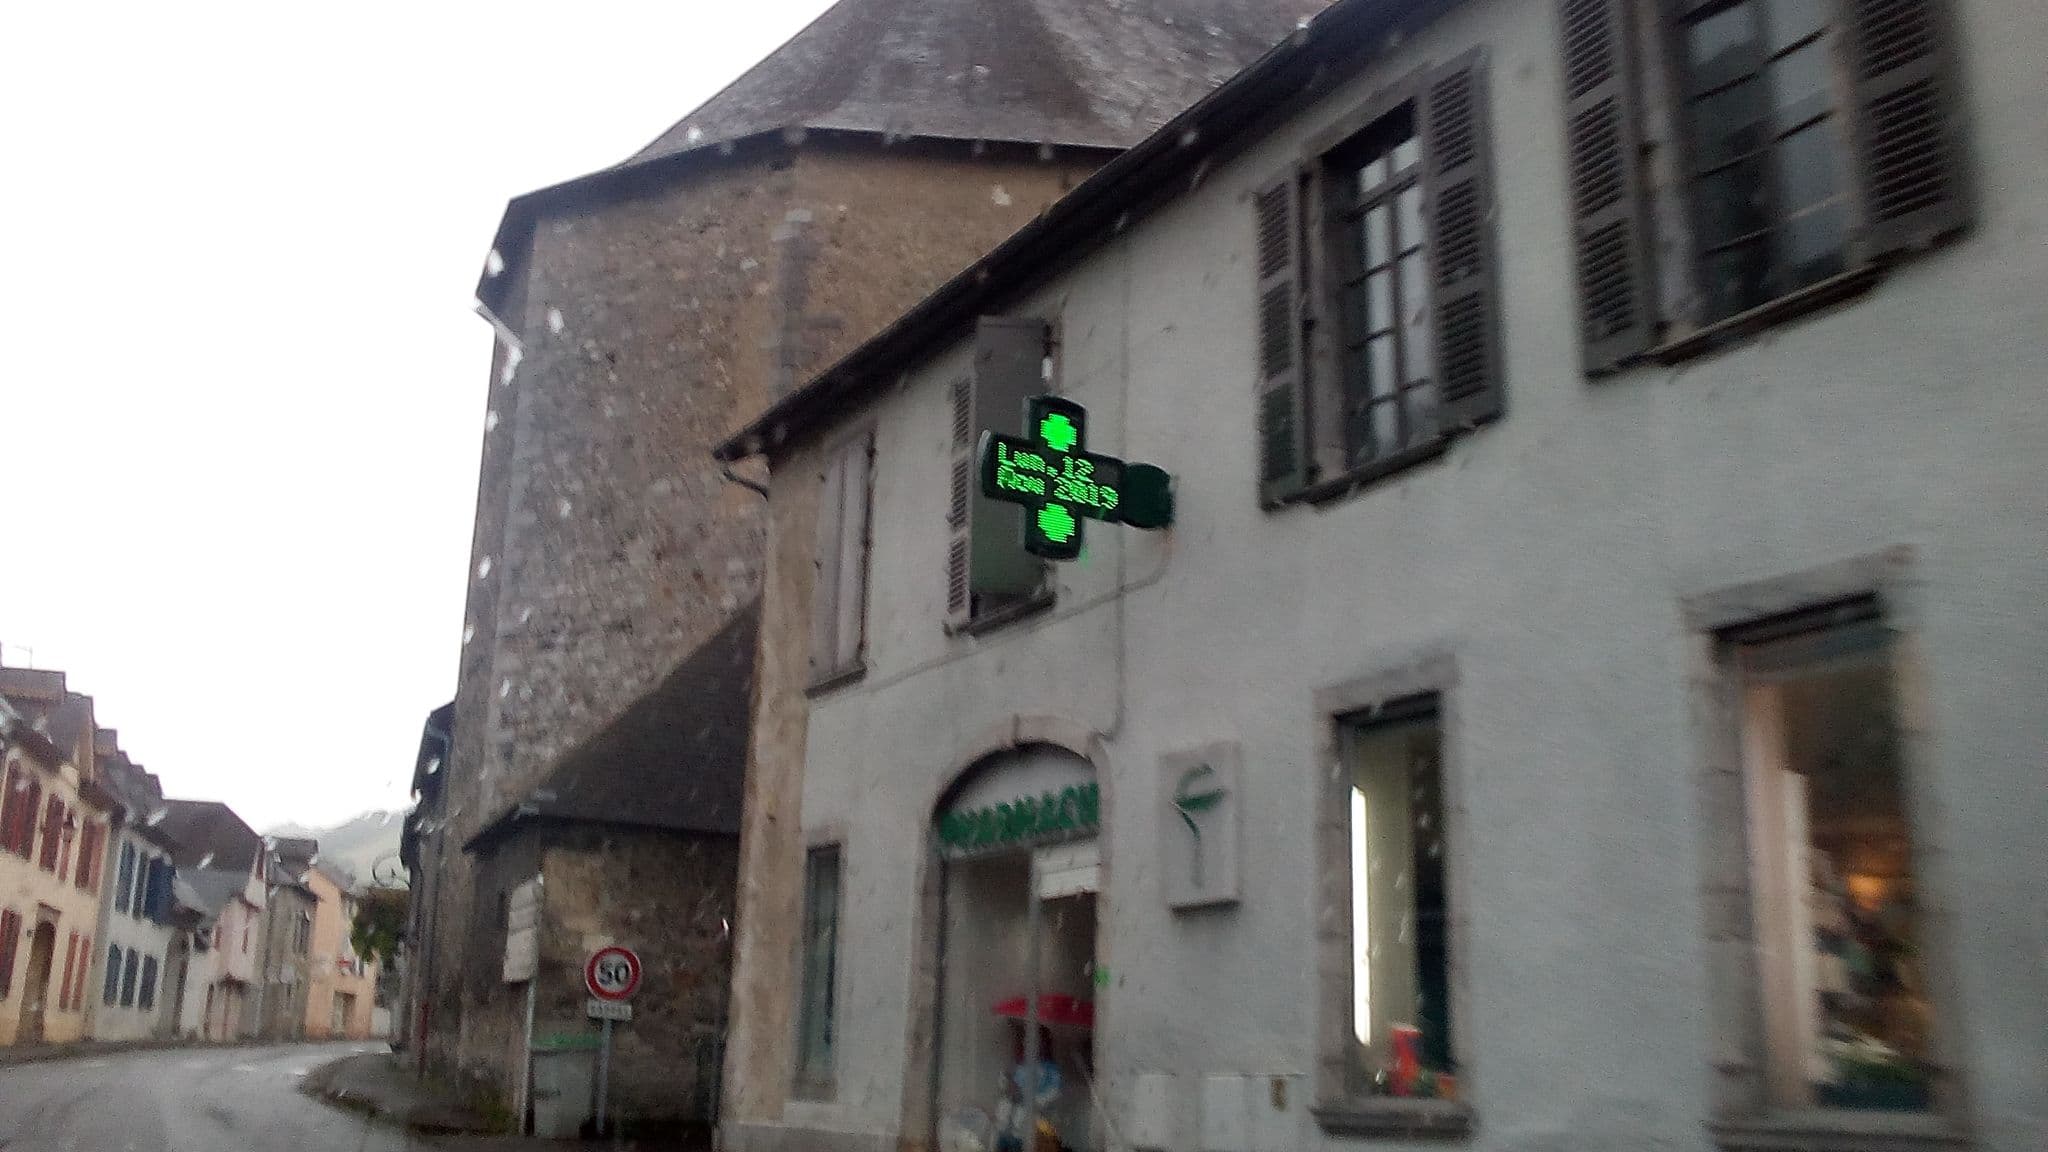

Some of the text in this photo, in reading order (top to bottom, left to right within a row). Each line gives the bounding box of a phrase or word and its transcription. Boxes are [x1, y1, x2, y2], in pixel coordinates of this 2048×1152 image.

[998, 442, 1095, 483] Lun. 12
[1053, 476, 1119, 510] 2019
[599, 961, 630, 985] 50
